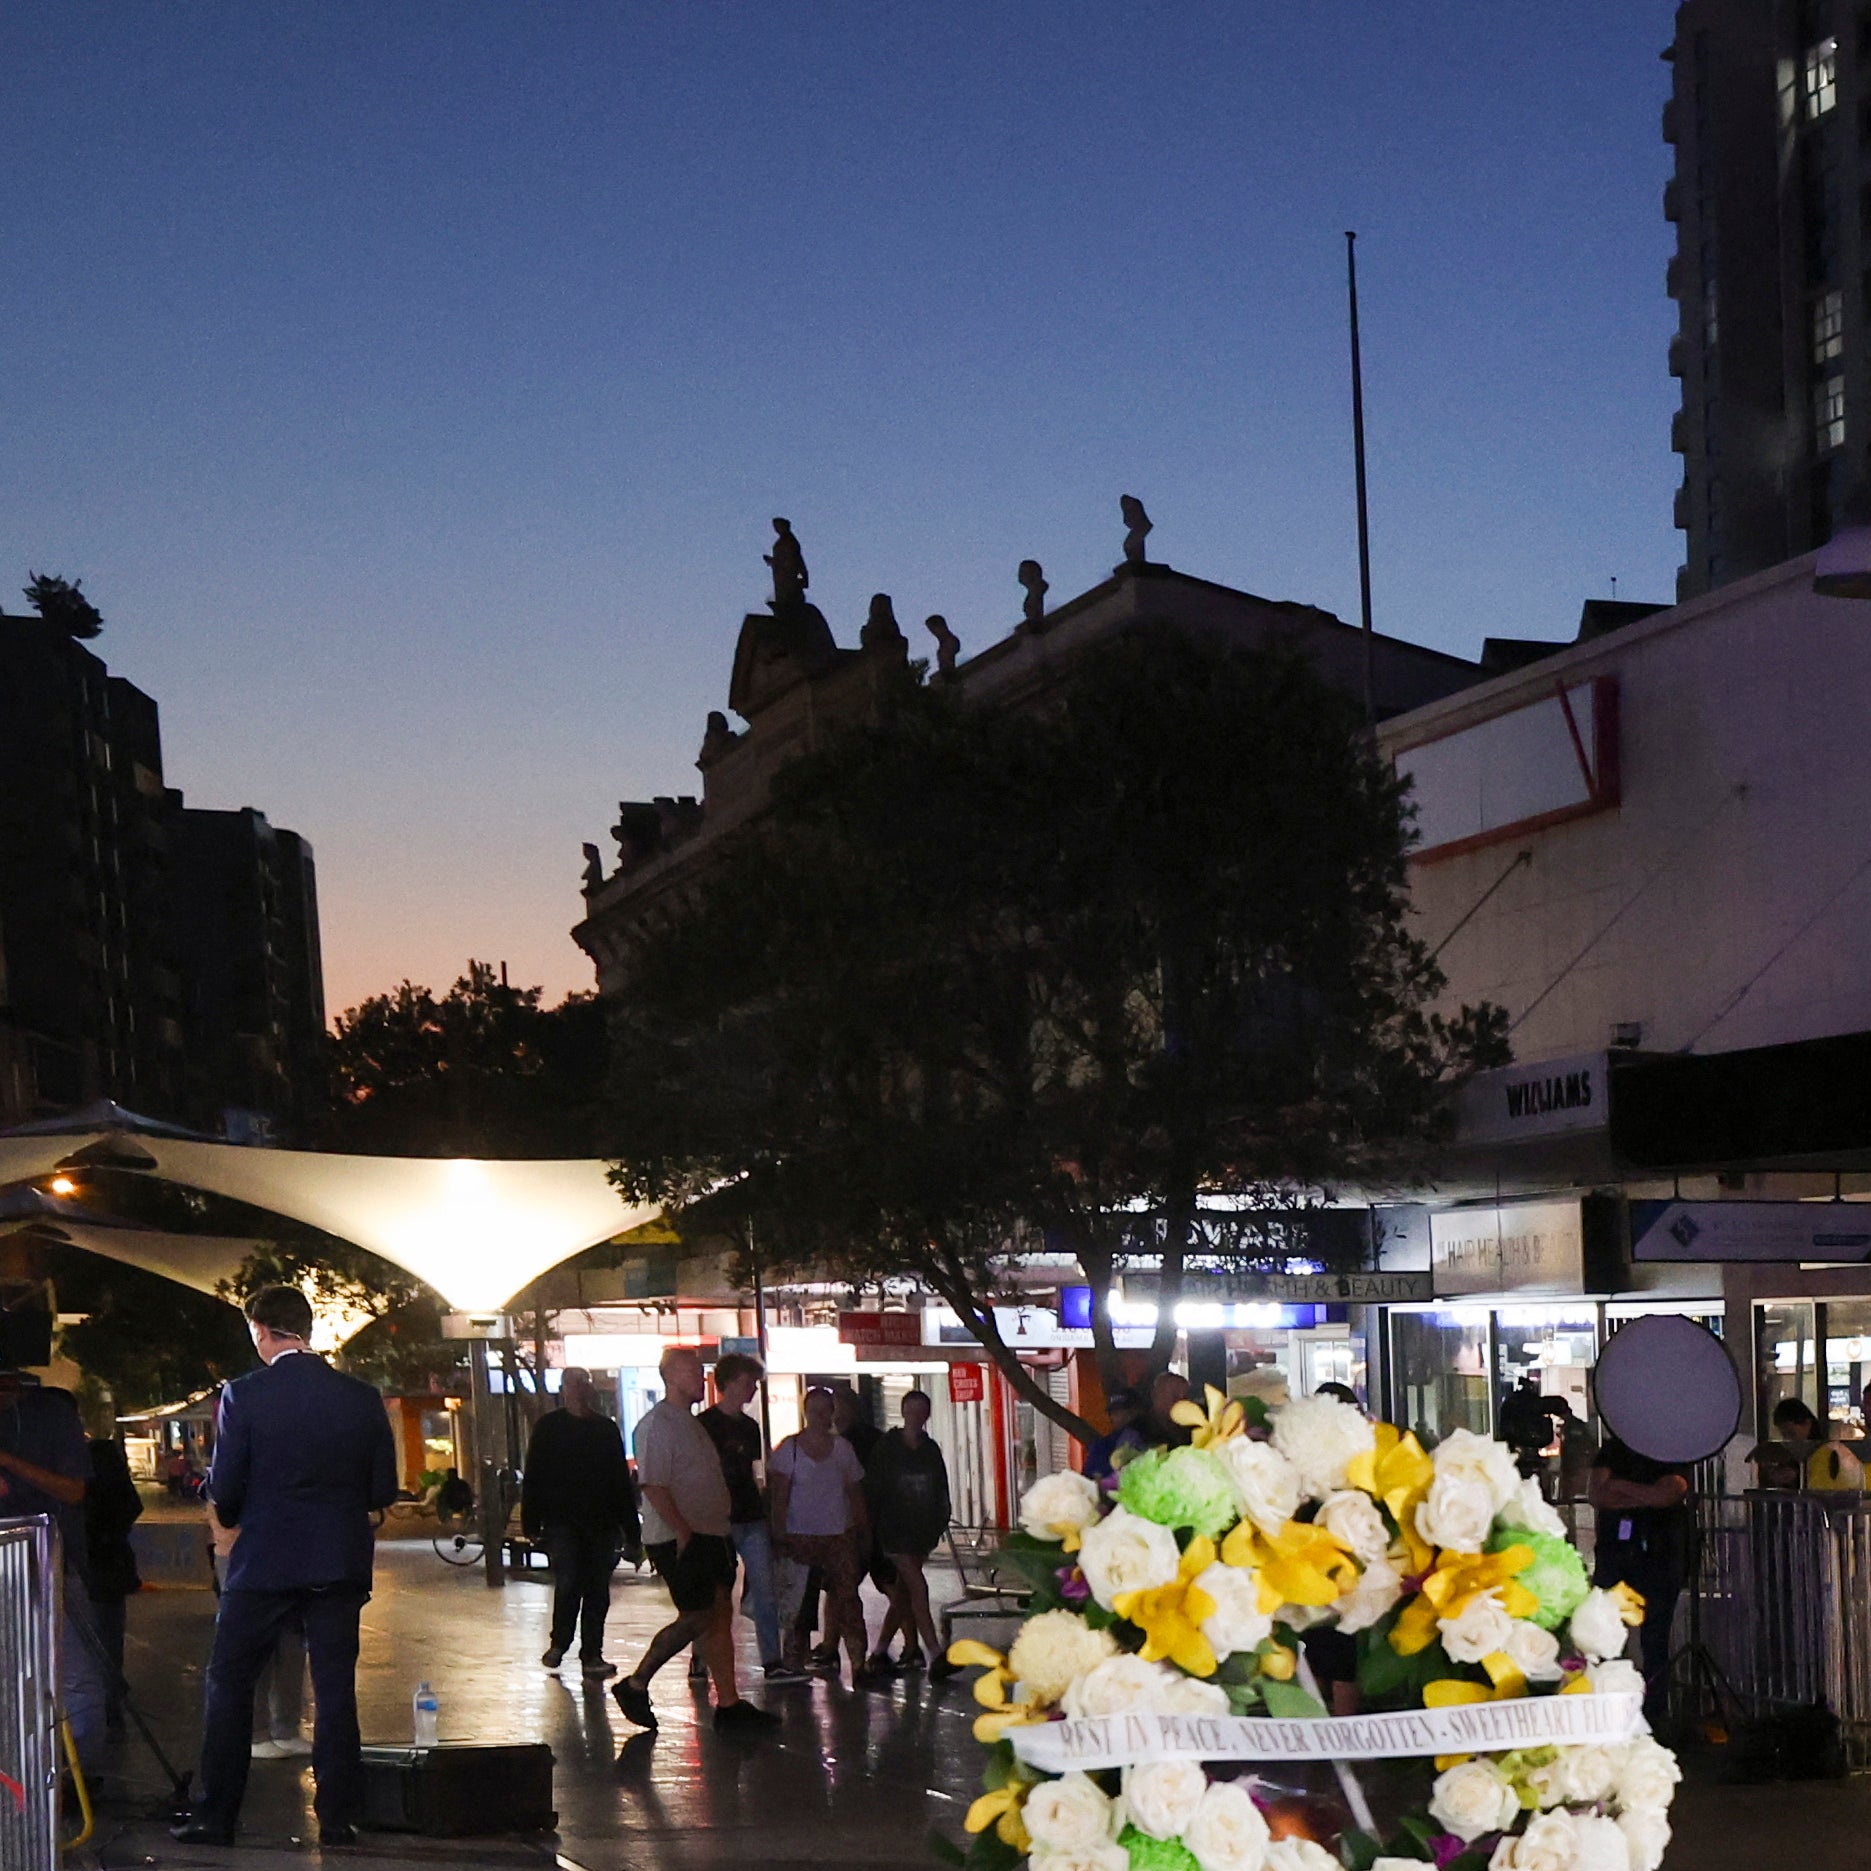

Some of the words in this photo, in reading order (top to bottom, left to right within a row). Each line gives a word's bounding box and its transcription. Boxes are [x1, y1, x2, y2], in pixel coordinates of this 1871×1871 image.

[1505, 1069, 1592, 1118] WILLIAMS
[1060, 1719, 1112, 1758] REST
[1125, 1715, 1149, 1751] IN
[1240, 1722, 1311, 1752] NEVER
[1312, 1716, 1436, 1752] FORGOTTEN
[1448, 1701, 1575, 1744] SWEETHEART
